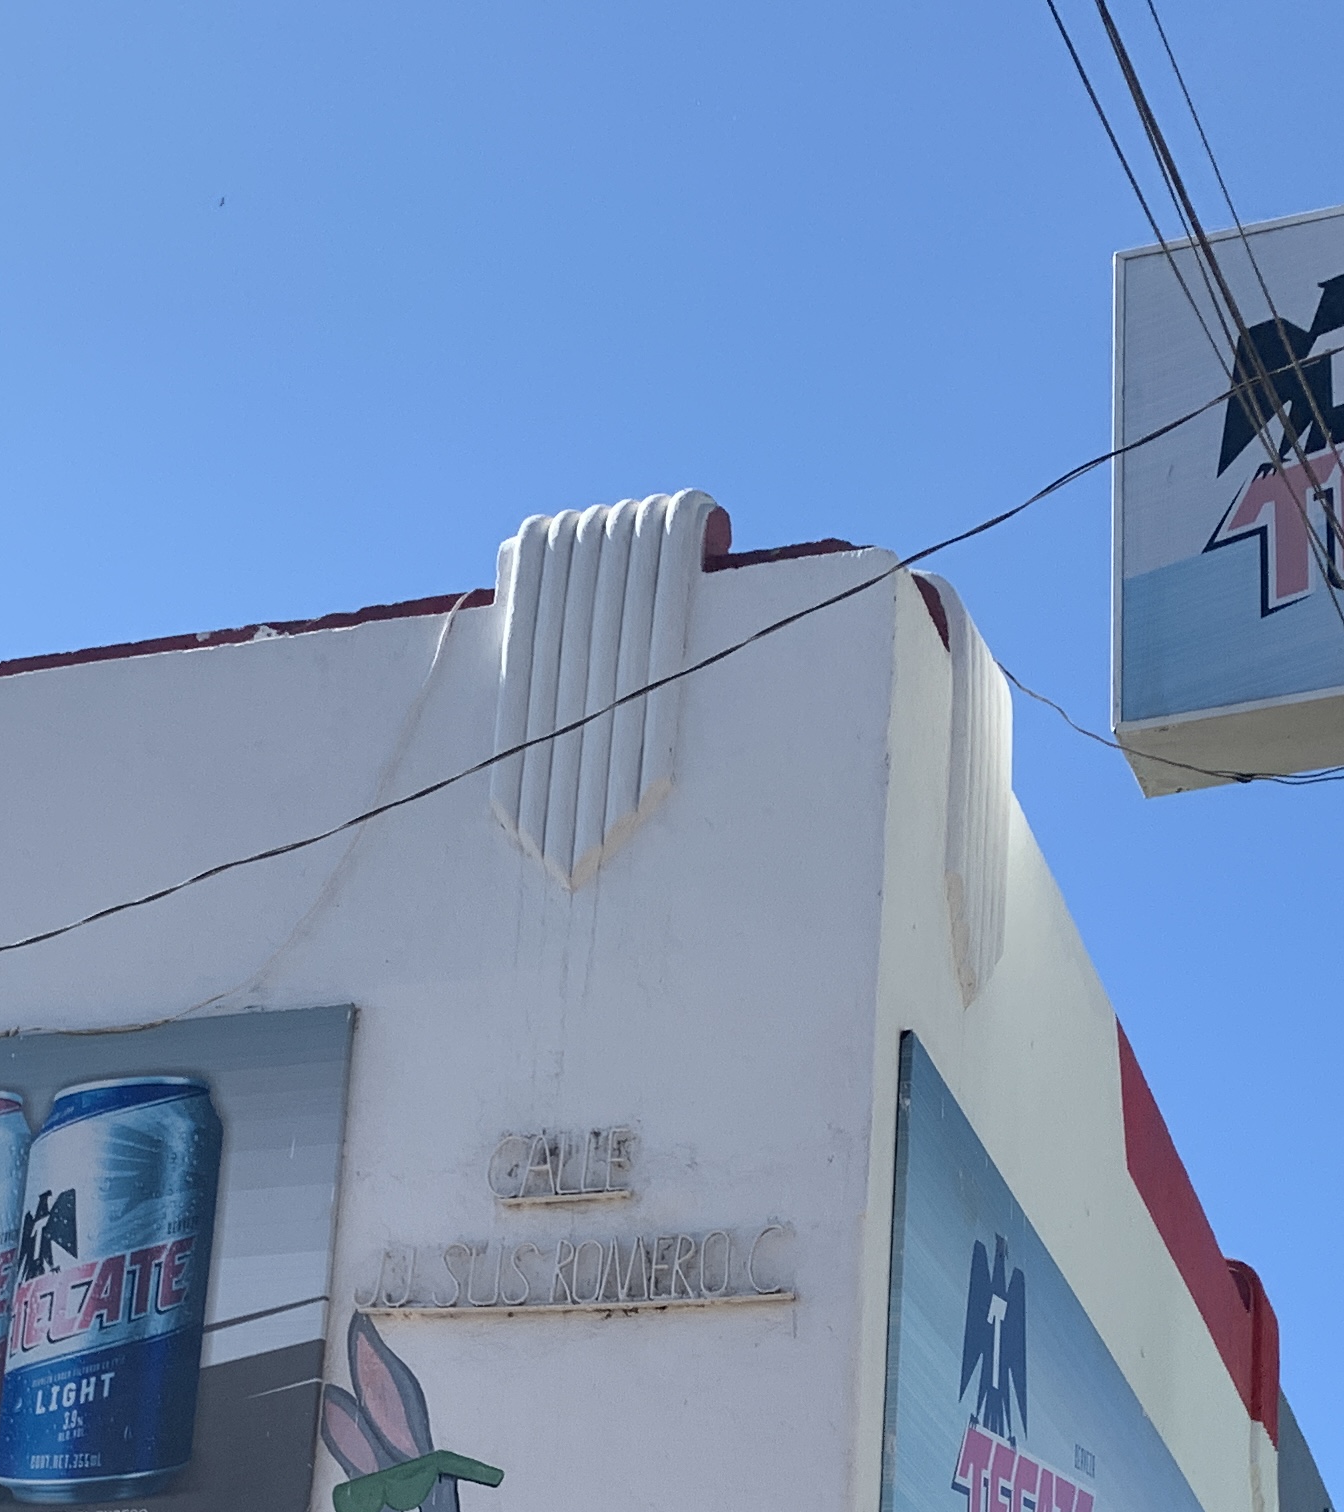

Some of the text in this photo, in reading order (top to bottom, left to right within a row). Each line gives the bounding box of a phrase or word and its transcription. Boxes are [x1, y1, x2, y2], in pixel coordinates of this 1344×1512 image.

[487, 1128, 632, 1199] CALLE
[9, 1235, 197, 1359] TECATE
[549, 1230, 730, 1303] ROMERO
[34, 1372, 116, 1416] LIGHT
